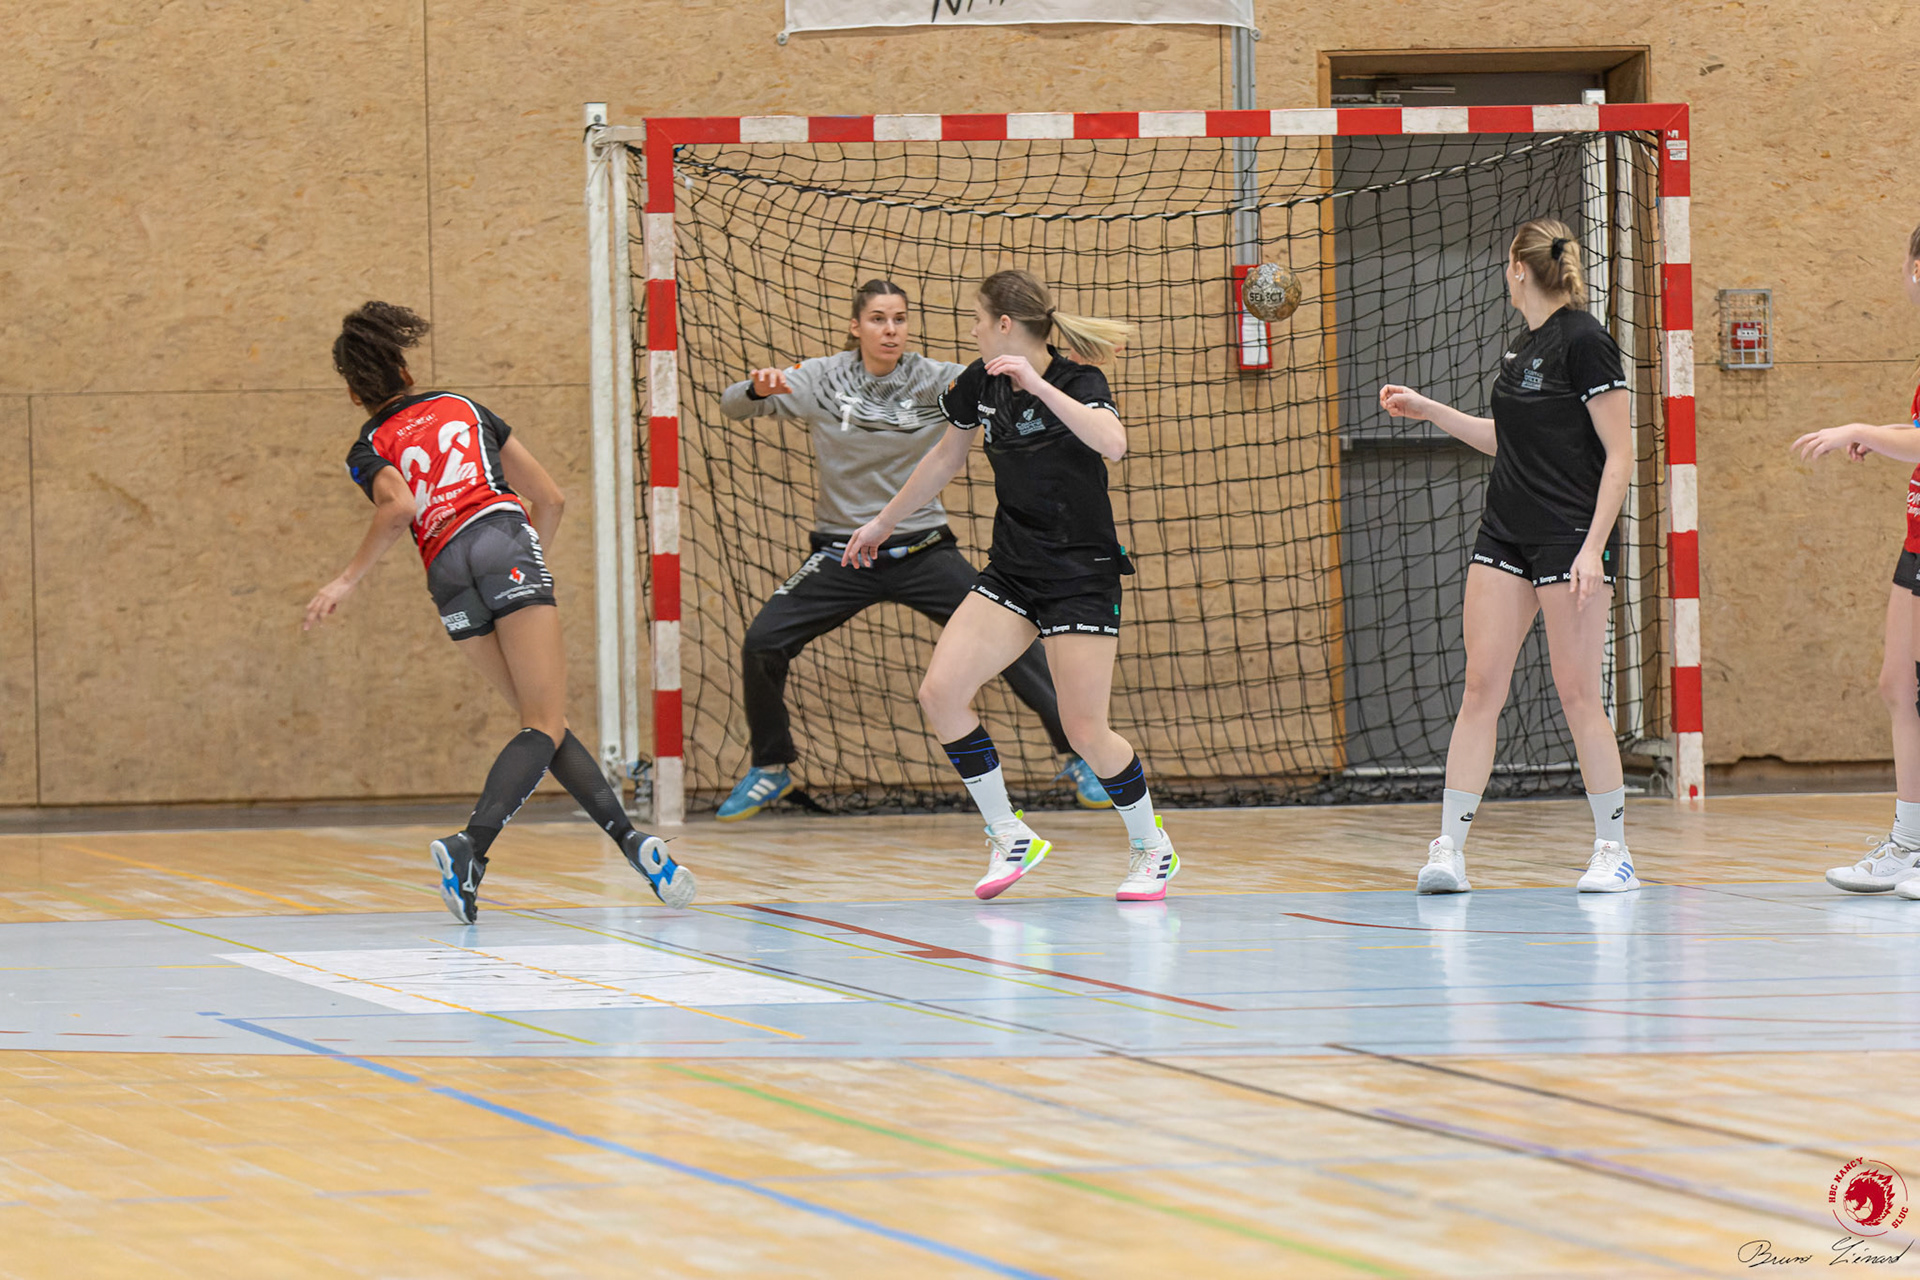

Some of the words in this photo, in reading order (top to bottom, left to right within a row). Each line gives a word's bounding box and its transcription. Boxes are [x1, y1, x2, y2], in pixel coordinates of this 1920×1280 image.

[1249, 291, 1284, 303] SELECT
[400, 420, 478, 527] 22
[773, 552, 825, 595] Kempa
[1474, 553, 1494, 564] Kempa
[1499, 560, 1524, 575] Kempa
[977, 585, 1000, 601] Kempa
[1004, 599, 1028, 616] Kempa
[1077, 623, 1100, 633] Kempa
[1104, 625, 1118, 635] Kemp
